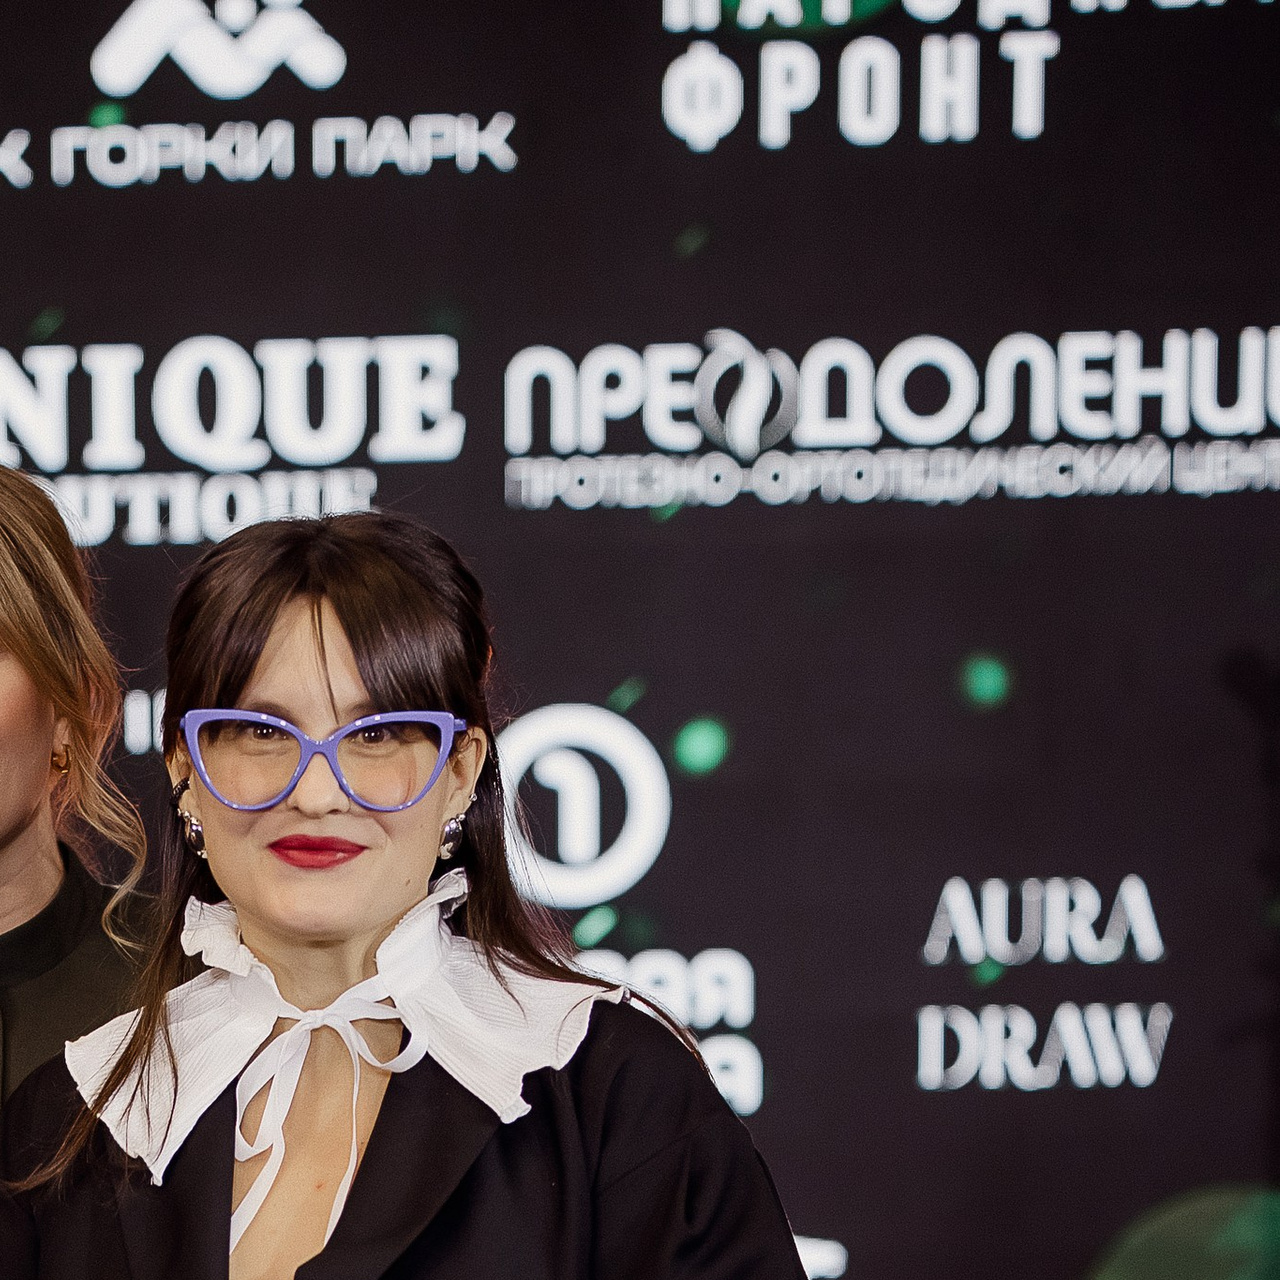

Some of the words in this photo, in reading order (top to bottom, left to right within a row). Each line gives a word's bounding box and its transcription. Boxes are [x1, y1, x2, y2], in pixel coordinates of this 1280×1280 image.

[661, 29, 1061, 153] ФРОНТ
[50, 119, 295, 187] ГОРКИ
[312, 112, 517, 178] ПАРК
[504, 325, 1280, 460] ПРЕОДОЛЕНИ
[923, 872, 1166, 966] AURA
[916, 1001, 1174, 1091] DRAW
